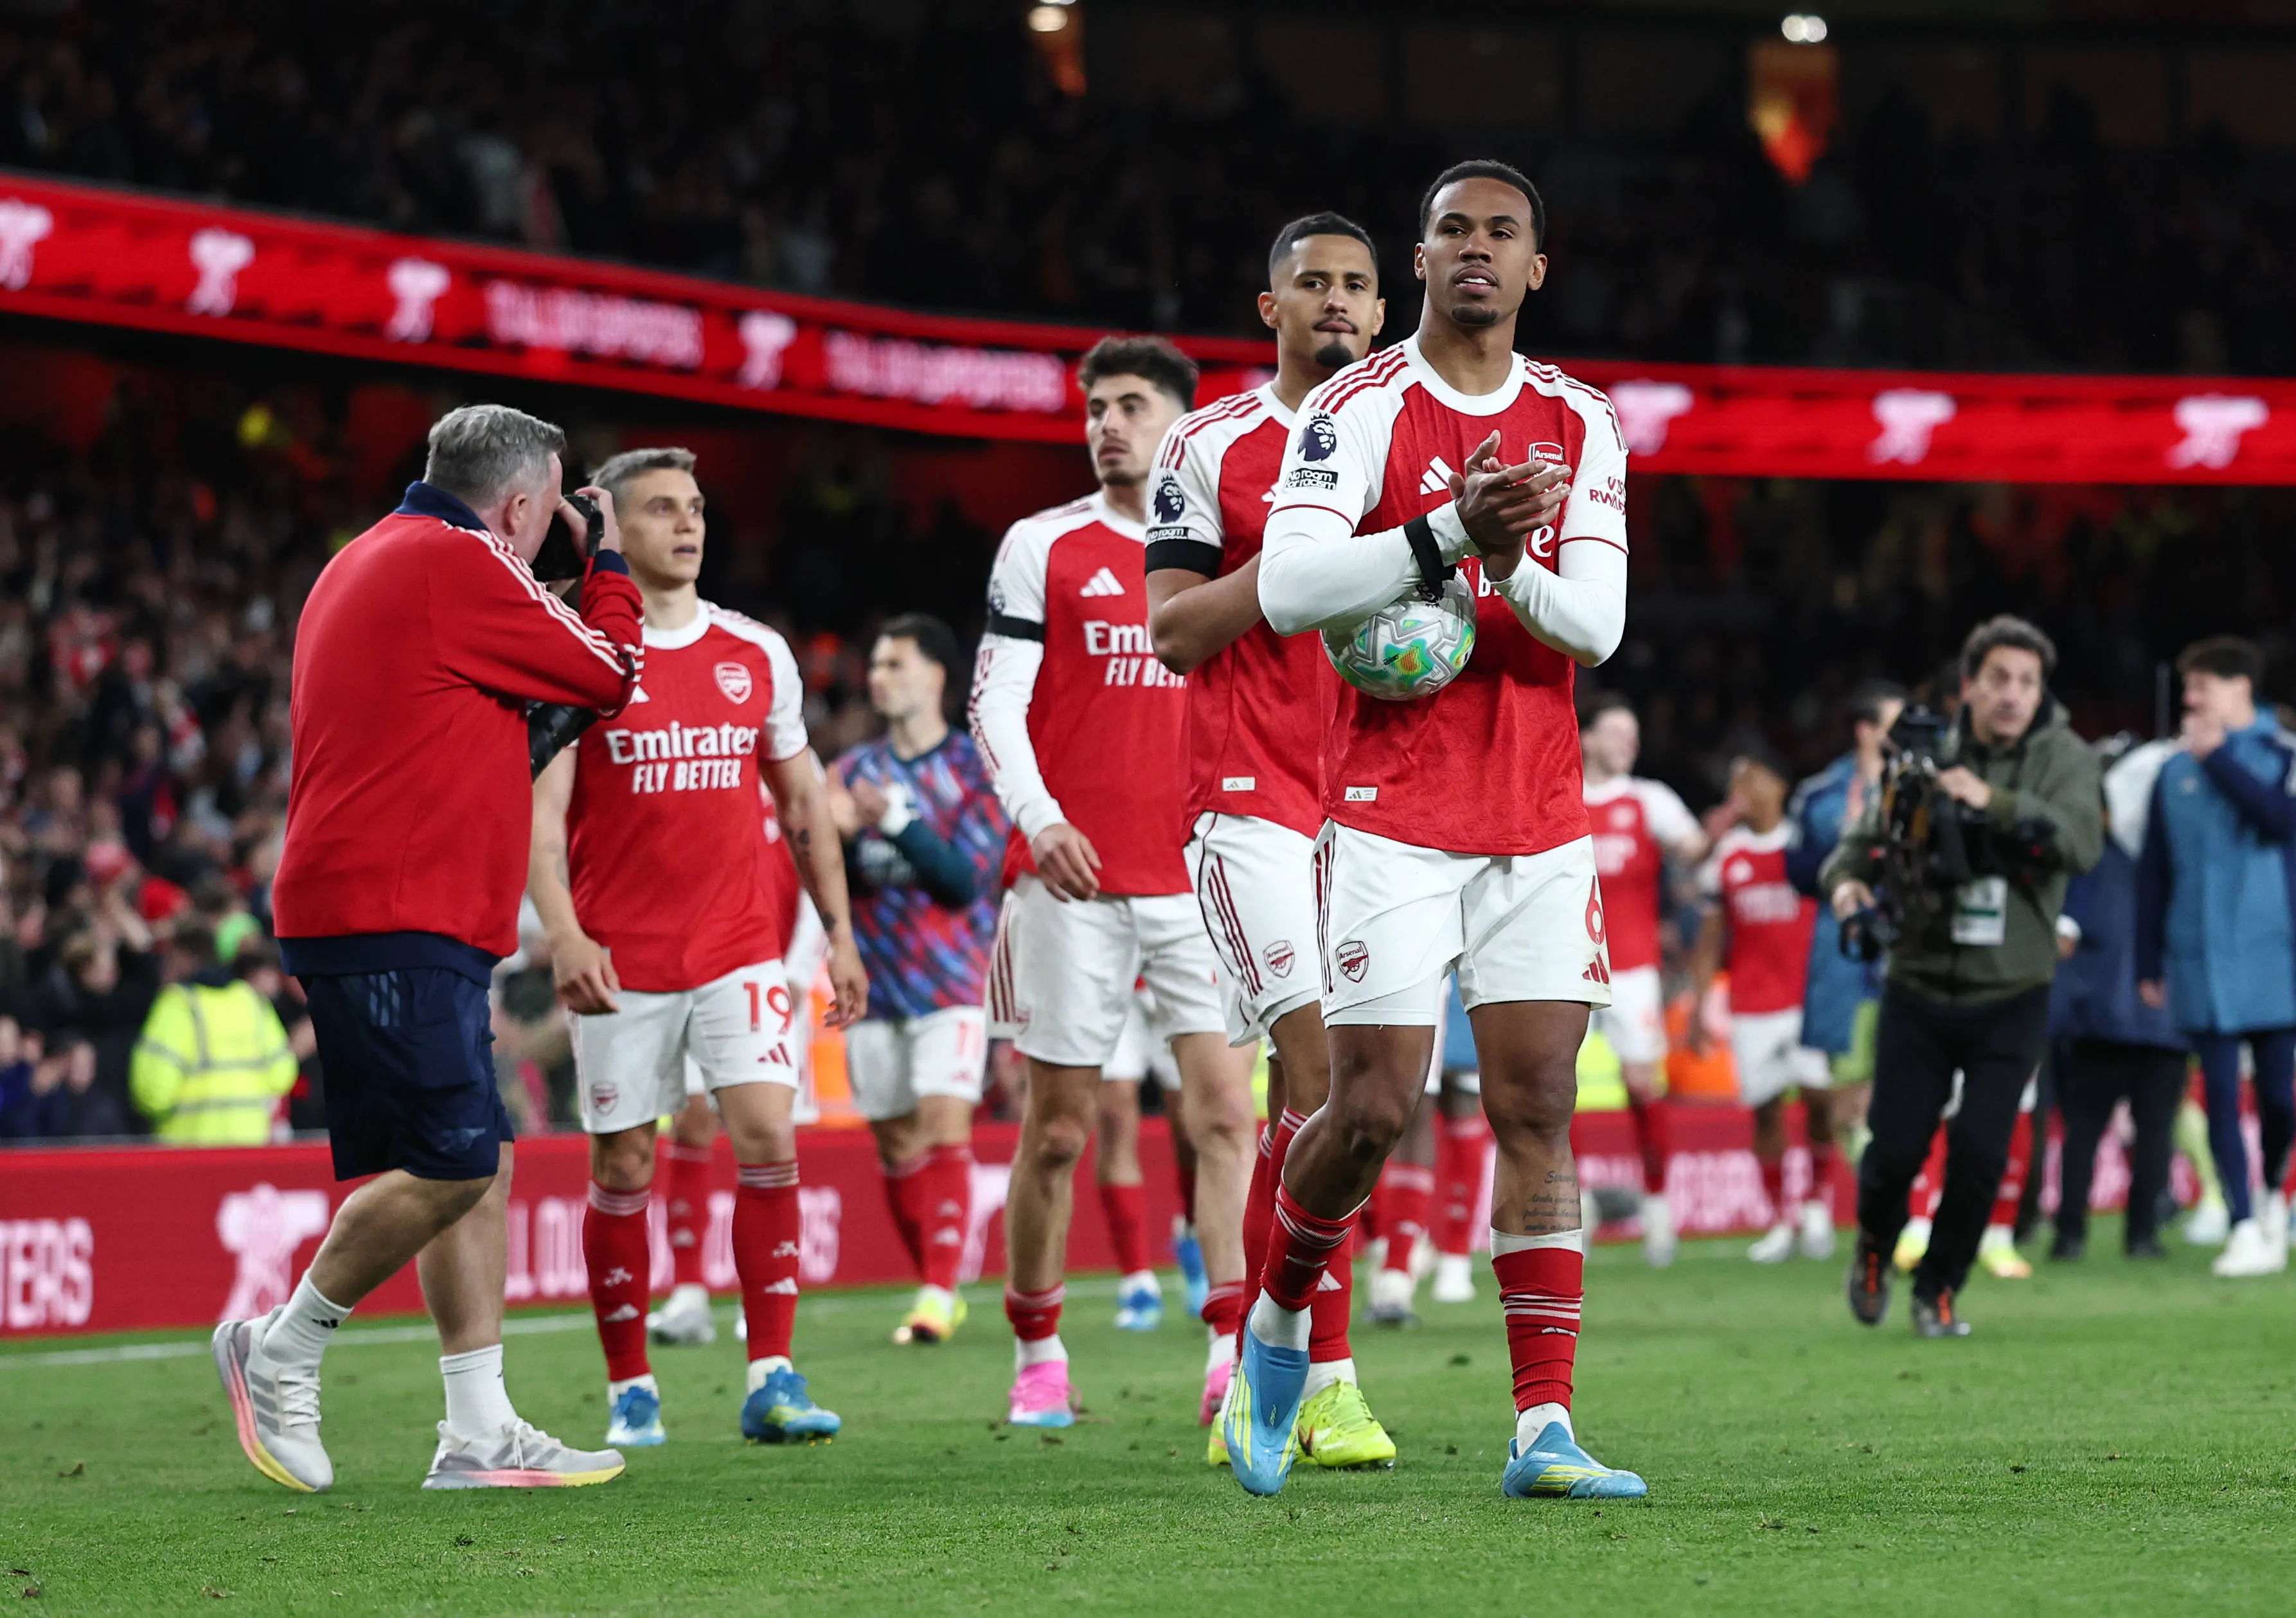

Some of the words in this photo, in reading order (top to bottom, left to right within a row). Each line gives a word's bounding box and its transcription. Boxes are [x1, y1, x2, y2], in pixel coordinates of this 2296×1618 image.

[1535, 450, 1563, 461] Arsenal
[1287, 471, 1301, 481] No
[1301, 470, 1332, 482] room
[1299, 478, 1336, 490] racism
[1105, 657, 1141, 686] FLY
[605, 720, 759, 764] Emirates
[631, 763, 669, 794] FLY
[673, 758, 742, 792] BETTER
[1585, 875, 1605, 945] 6
[1339, 947, 1362, 959] Arsenal
[743, 982, 792, 1036] 19
